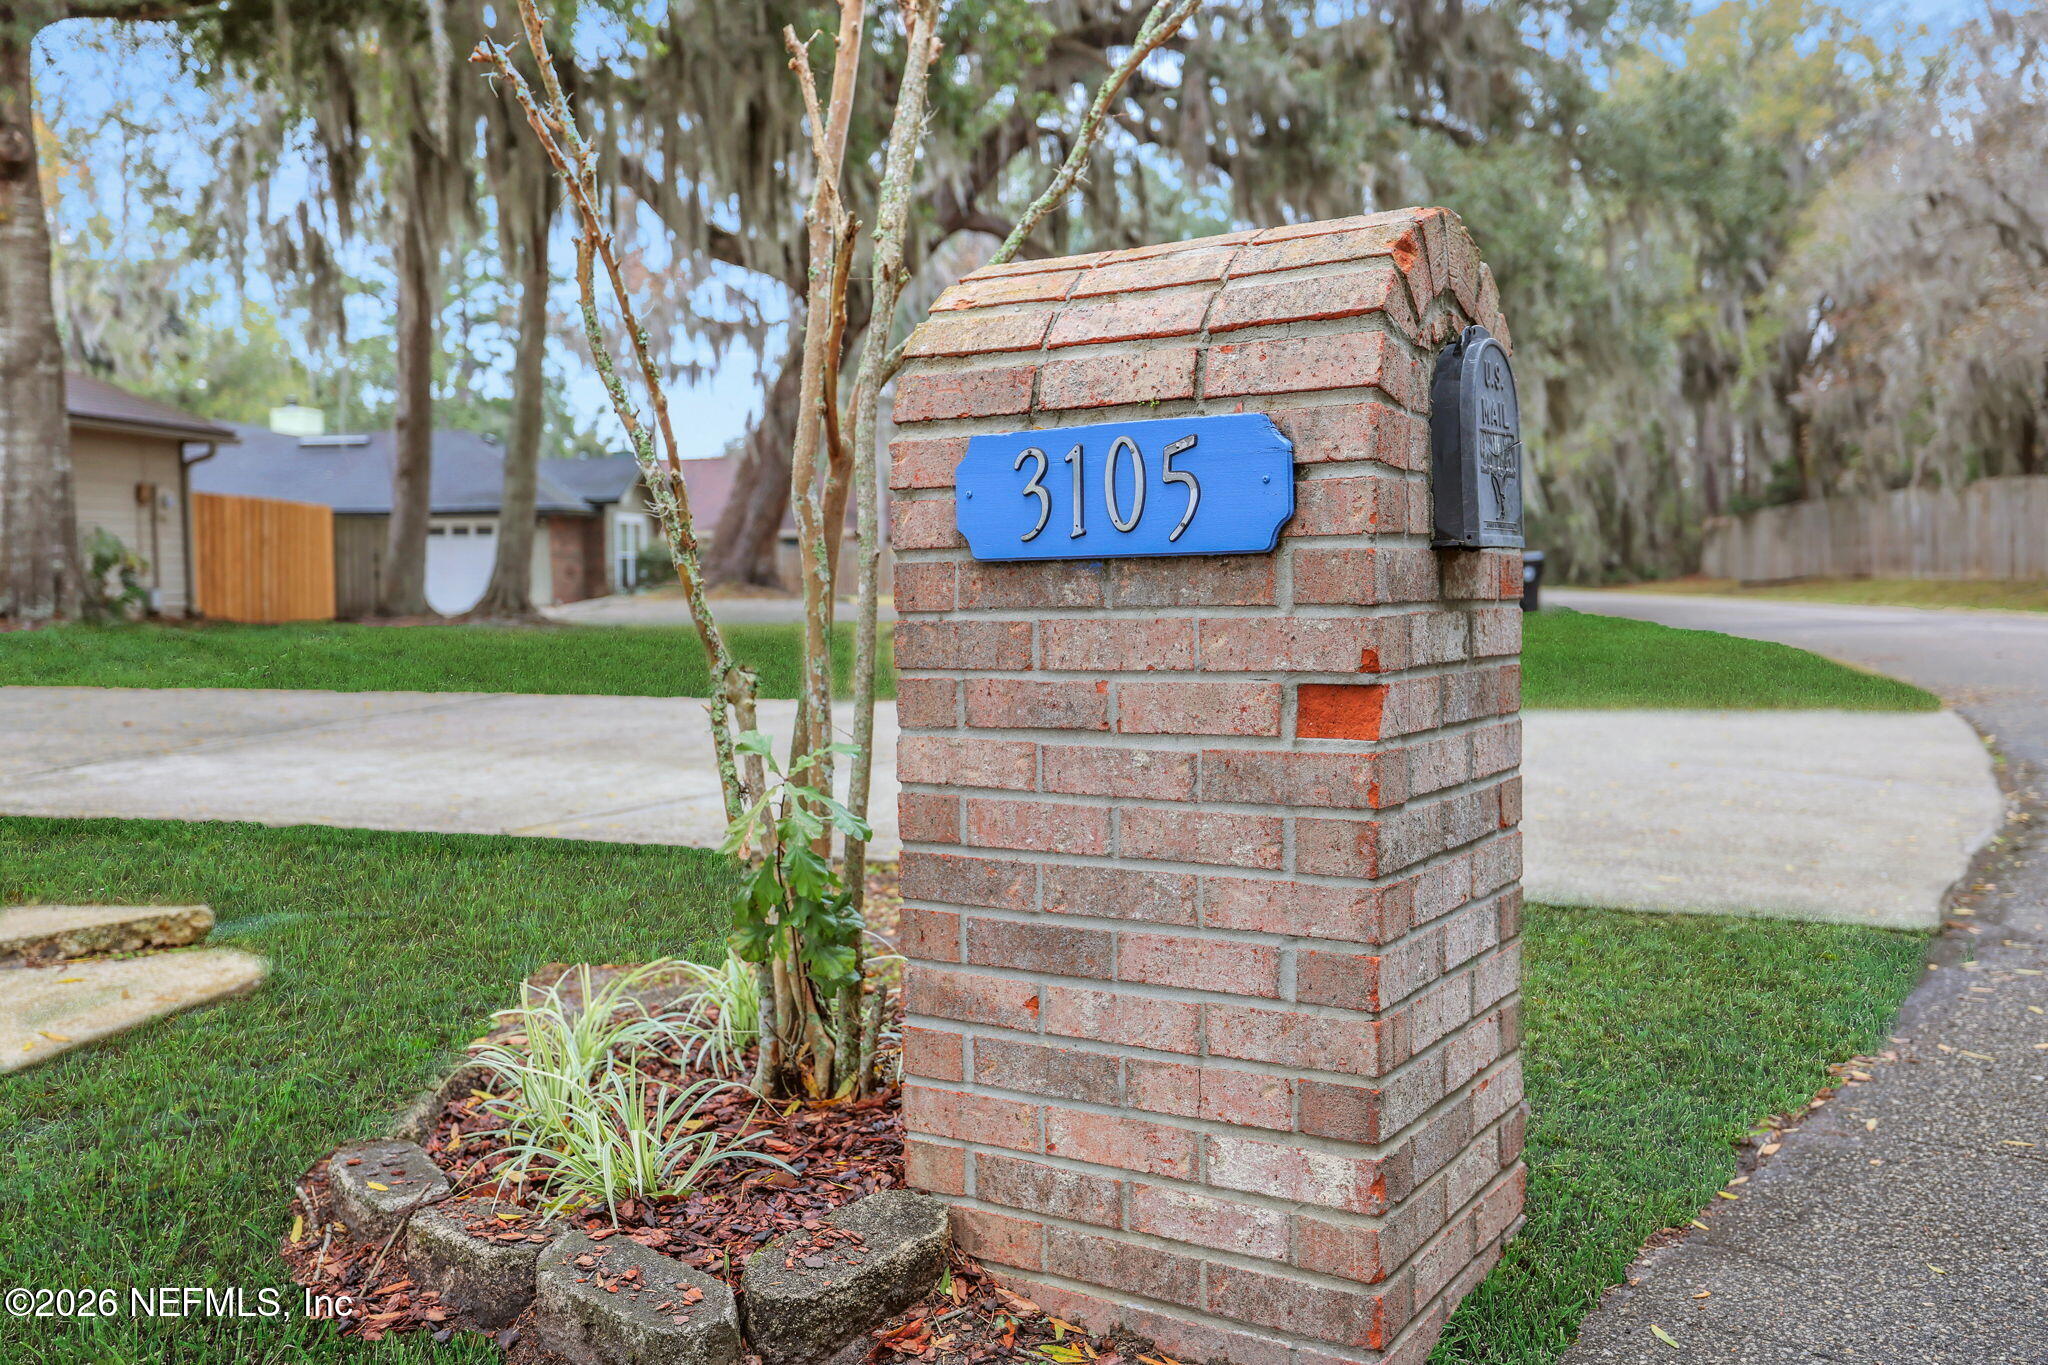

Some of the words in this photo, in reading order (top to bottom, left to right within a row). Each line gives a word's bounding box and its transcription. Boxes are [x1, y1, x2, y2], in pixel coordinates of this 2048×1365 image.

[1483, 359, 1504, 391] U.S.
[1480, 397, 1510, 430] MAIL
[1013, 433, 1201, 543] 3105
